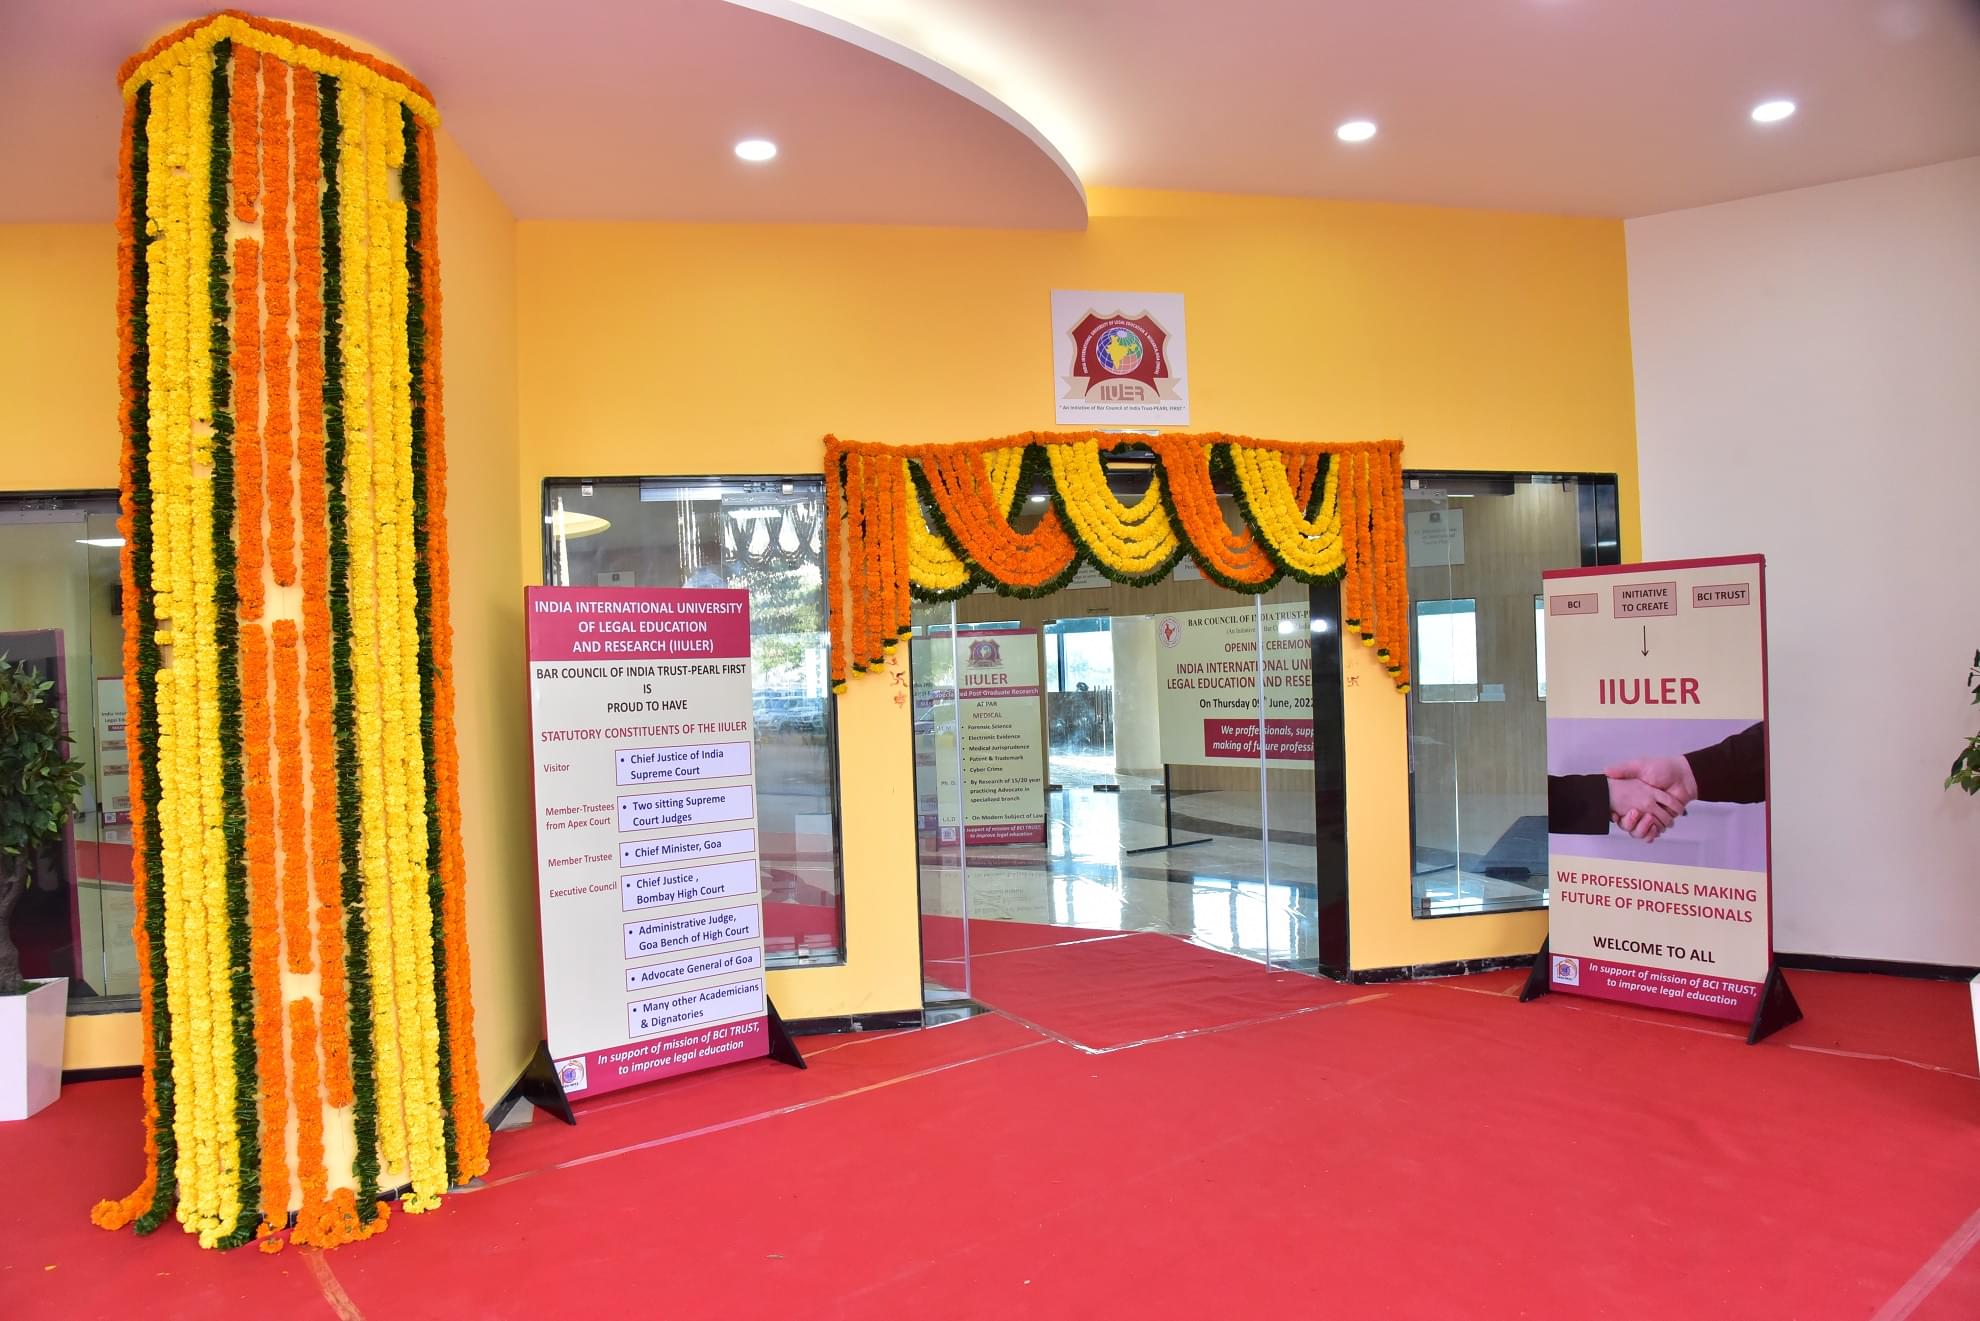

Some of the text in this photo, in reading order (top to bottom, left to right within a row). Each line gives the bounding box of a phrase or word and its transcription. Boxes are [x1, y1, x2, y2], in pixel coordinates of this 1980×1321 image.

[1622, 589, 1668, 598] INITIATIVE
[1697, 591, 1746, 601] BCI TRUST
[535, 601, 743, 614] INDIA INTERNATIONAL UNIVERSITY
[1568, 601, 1581, 609] BCI
[1622, 602, 1669, 612] TO CREATE
[579, 621, 707, 633] OF LEGAL EDUCATION
[1188, 615, 1250, 627] BAR COUNCIL OF
[573, 639, 714, 653] AND RESEARCH (IIULER)
[536, 664, 746, 679] BAR COUNCIL OF INDIA TRUST-PEARL FIRST
[1177, 663, 1203, 674] INDIA
[965, 674, 1008, 685] IIULER
[1167, 677, 1255, 689] LEGAL EDUCATION
[643, 684, 652, 694] IS
[1599, 678, 1700, 705] IIULER
[607, 700, 688, 712] PROUD TO HAVE
[1200, 699, 1211, 708] On
[1214, 698, 1250, 709] Thursday
[1269, 698, 1292, 709] June,
[541, 721, 747, 742] STATUTORY CONSTITUENTS OF THE IIULER
[1221, 726, 1233, 734] We
[1213, 741, 1252, 752] making of
[631, 750, 724, 764] Chief Justice of India
[543, 764, 570, 772] Visitor
[631, 766, 700, 781] Supreme Court
[546, 803, 615, 816] Member-Trustees
[633, 794, 726, 811] Two sitting Supreme
[546, 817, 611, 831] from Apex Court
[633, 813, 692, 827] Court Judges
[635, 839, 722, 858] Chief Minister, Goa
[548, 853, 613, 868] Member Trustee
[636, 874, 693, 889] Chief Justice
[1557, 871, 1757, 902] WE PROFESSIONALS MAKING
[549, 881, 617, 898] Executive Council
[637, 884, 725, 905] Bombay High Court
[1561, 891, 1753, 923] FUTURE OF PROFESSIONALS
[639, 912, 737, 936] Administrative Judge,
[639, 924, 749, 952] Goa Bench of High Court
[1593, 935, 1716, 964] WELCOME TO ALL
[641, 954, 753, 982] Advocate General of Goa
[1589, 963, 1757, 997] In support of mission of BCI TRUST,
[643, 982, 759, 1014] Many other Academicians
[1607, 978, 1737, 1006] to improve legal education
[641, 1008, 704, 1029] & Dignatories
[598, 1021, 760, 1065] In support of mission of BCI TRUST,
[618, 1039, 744, 1076] to improve legal education
